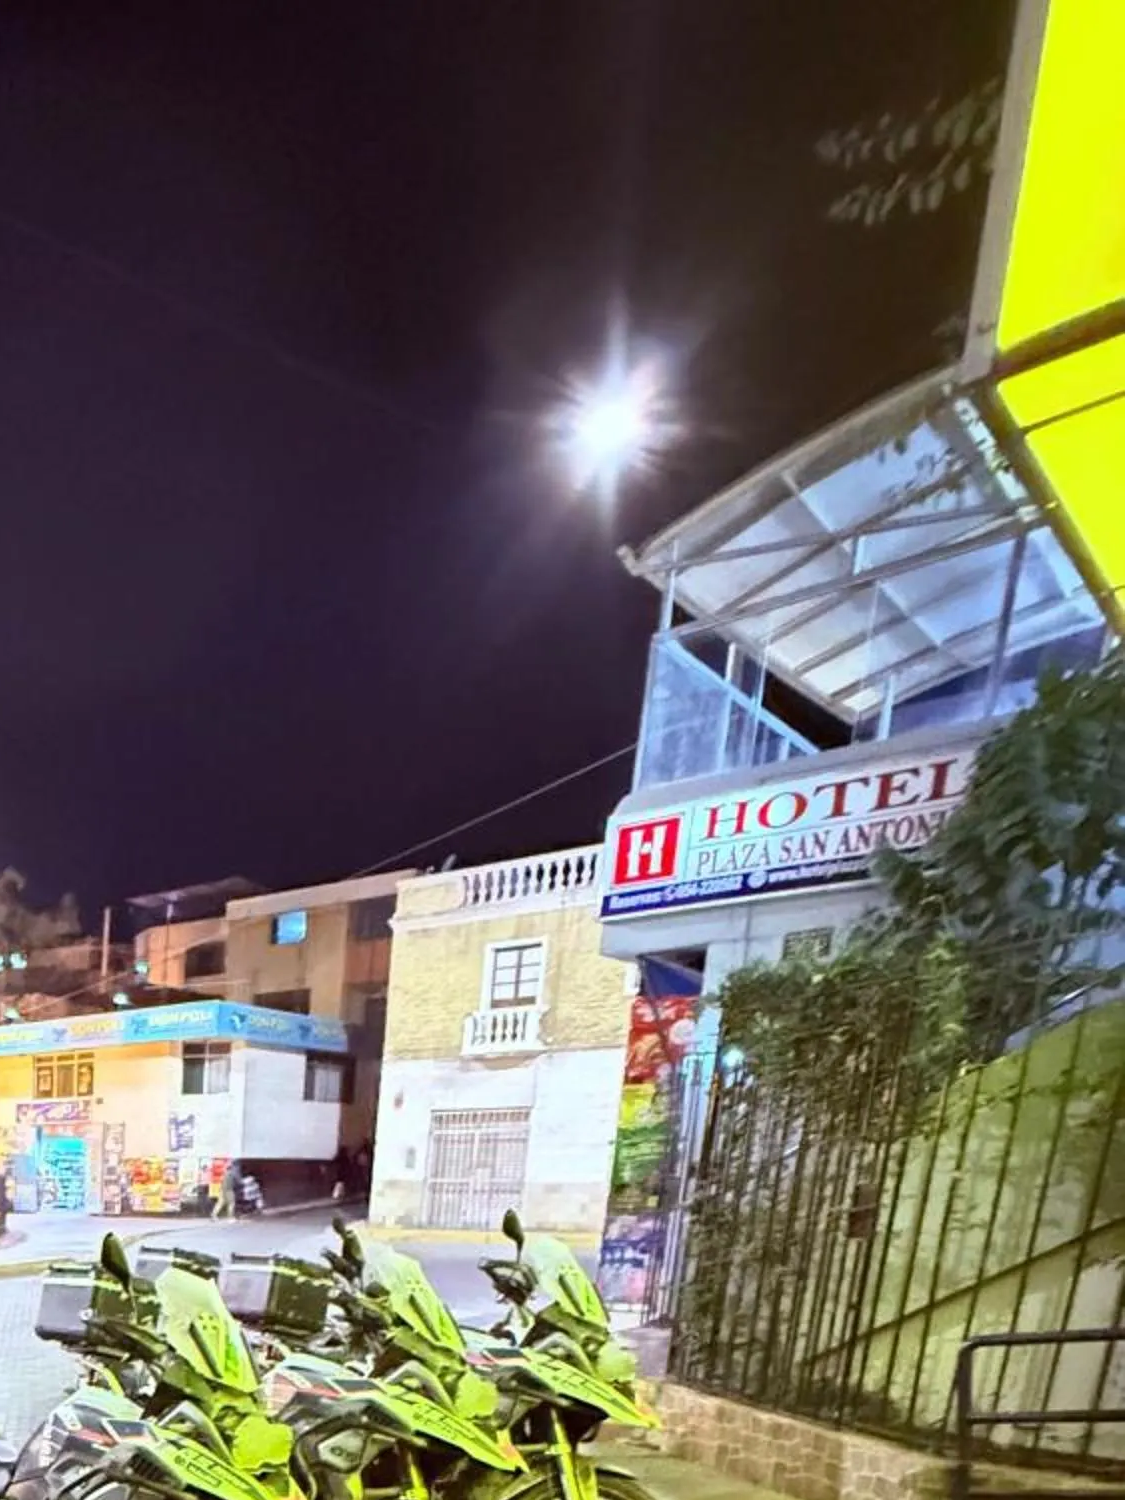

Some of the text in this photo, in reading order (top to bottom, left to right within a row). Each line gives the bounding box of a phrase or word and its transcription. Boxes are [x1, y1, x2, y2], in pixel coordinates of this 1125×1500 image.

[699, 758, 967, 841] HOTEL
[626, 825, 667, 879] H
[696, 840, 771, 877] PLAZA
[779, 829, 829, 863] SAN
